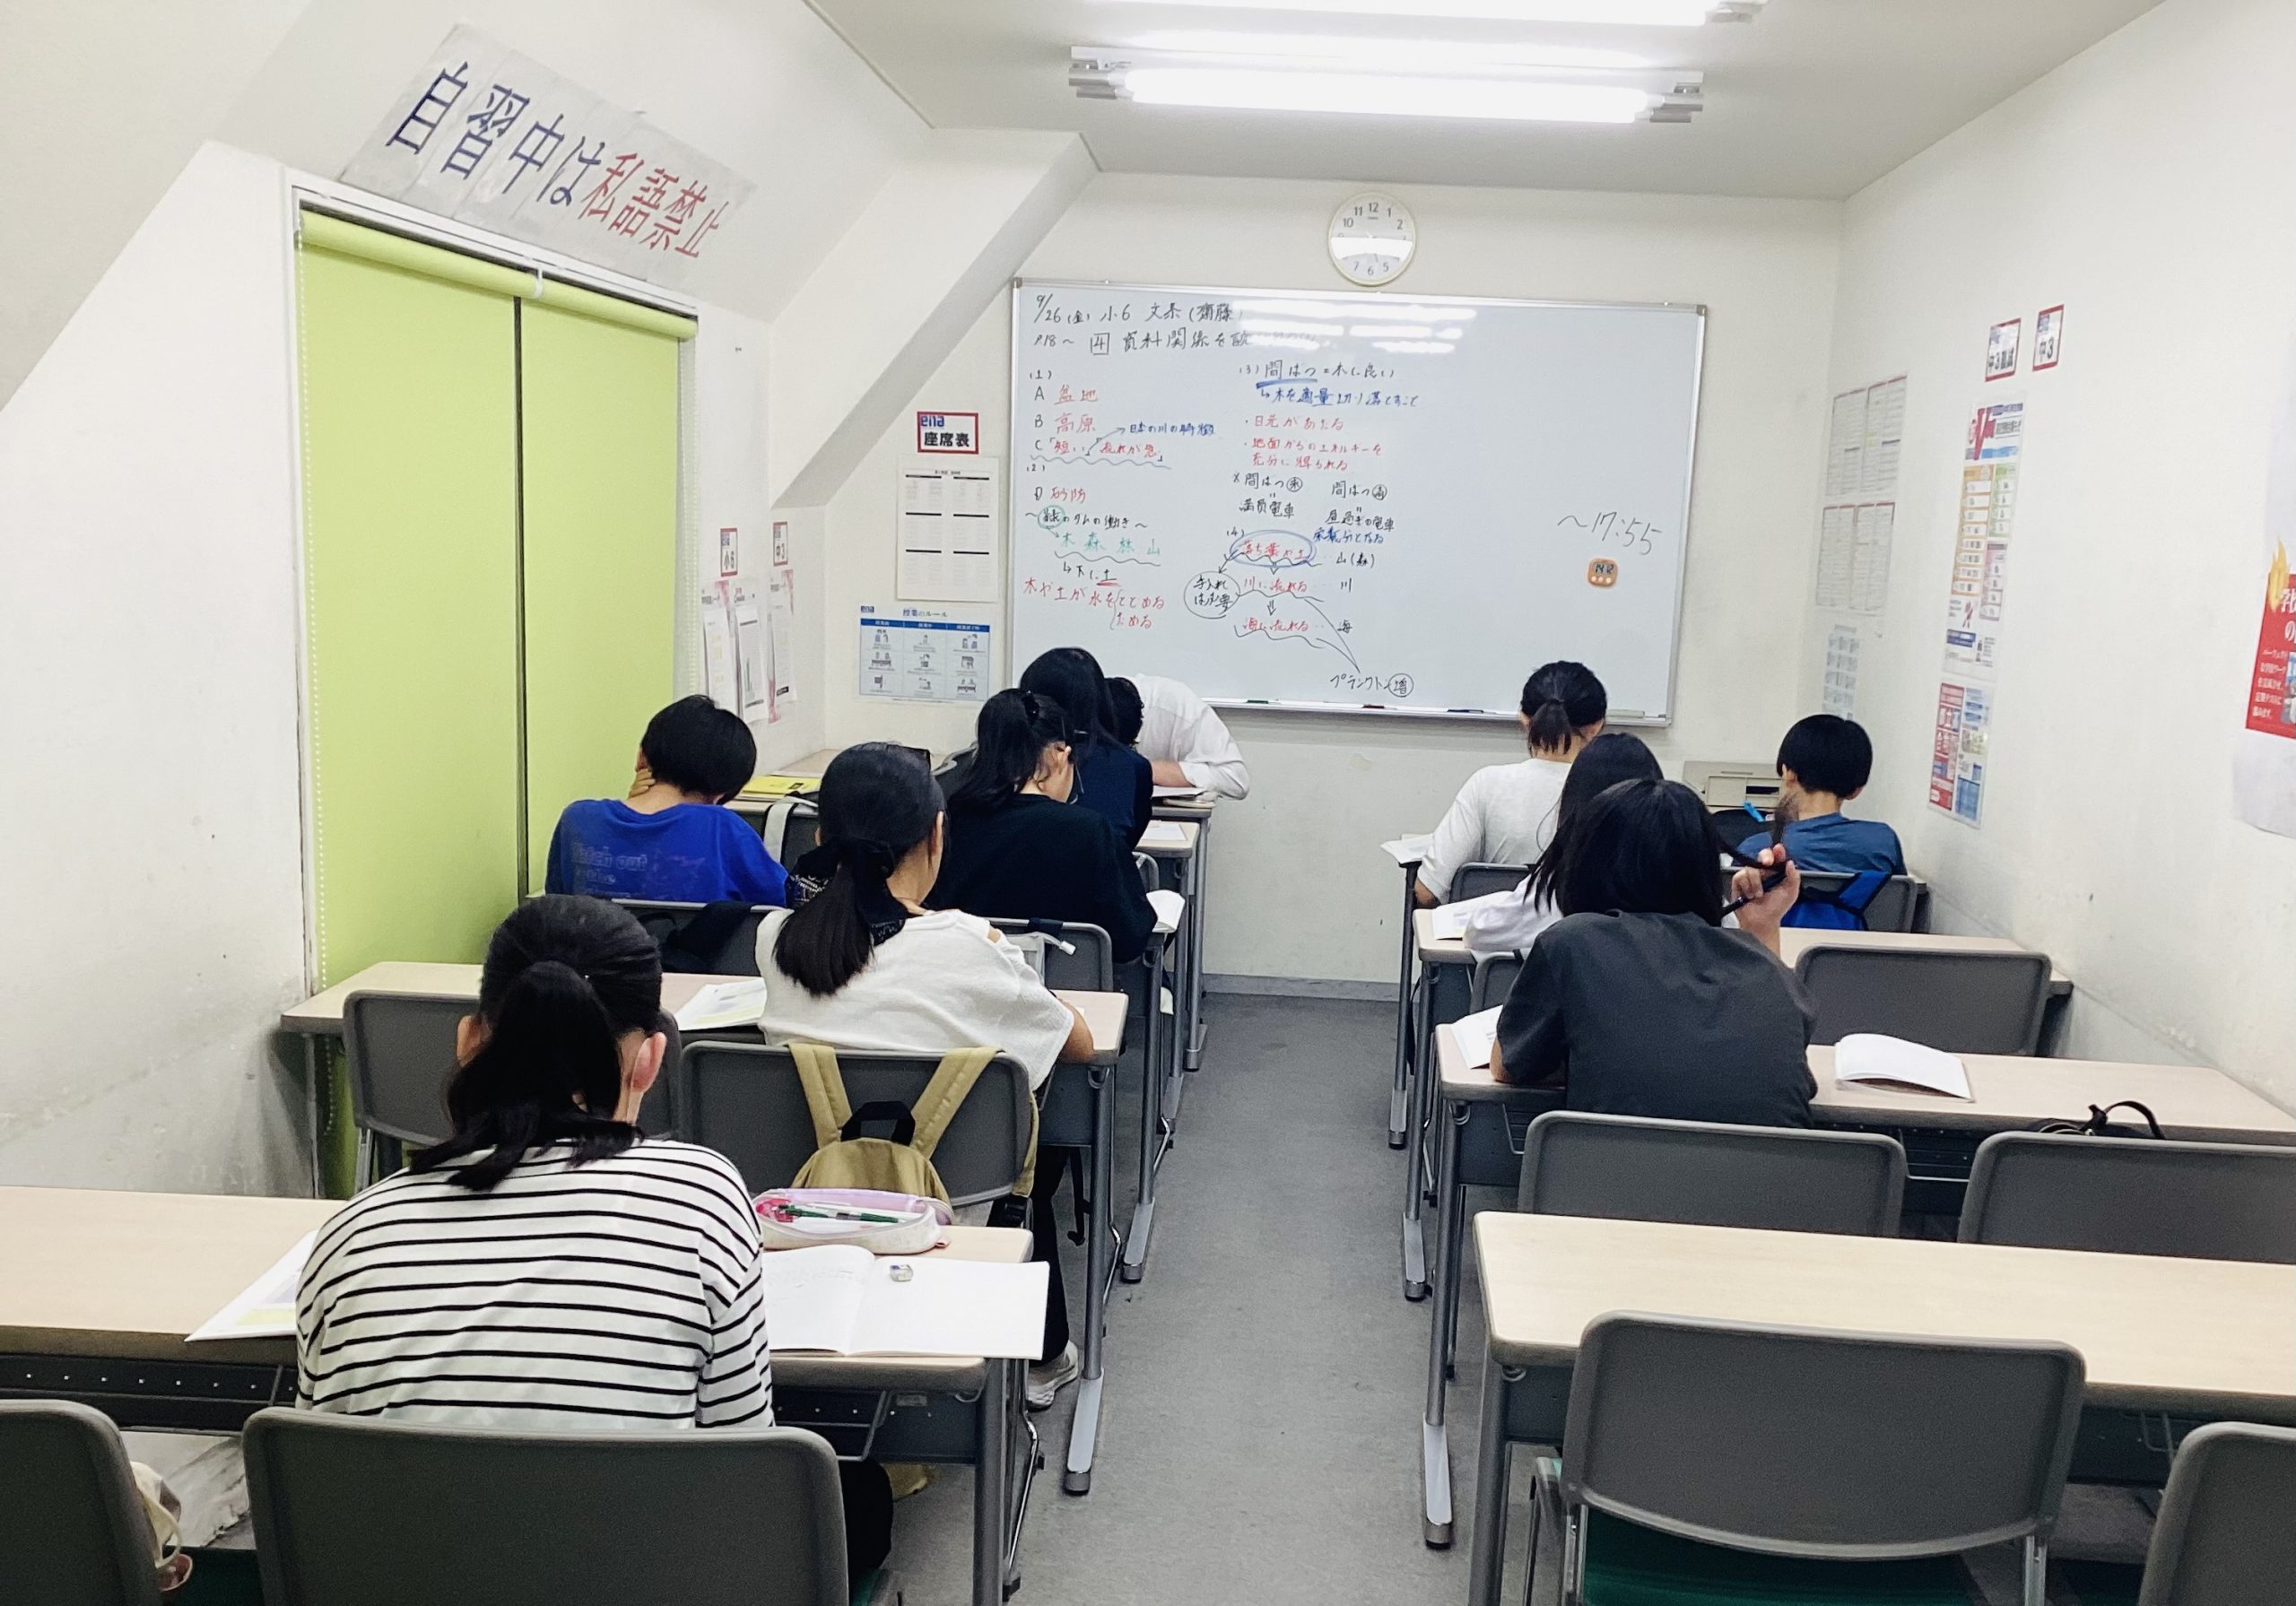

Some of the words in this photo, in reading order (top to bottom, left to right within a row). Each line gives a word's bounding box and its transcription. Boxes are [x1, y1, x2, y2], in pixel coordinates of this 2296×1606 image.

[386, 60, 730, 258] 自習中は私語禁止
[1354, 206, 1363, 216] 11
[1369, 202, 1378, 213] 12
[1387, 207, 1392, 218] 1
[1343, 217, 1353, 228] 10
[1396, 219, 1404, 230] 2
[1034, 385, 1045, 402] A
[920, 415, 945, 428] ena
[1034, 415, 1044, 429] B
[1054, 412, 1097, 434] 高原
[924, 431, 970, 447] 座席表
